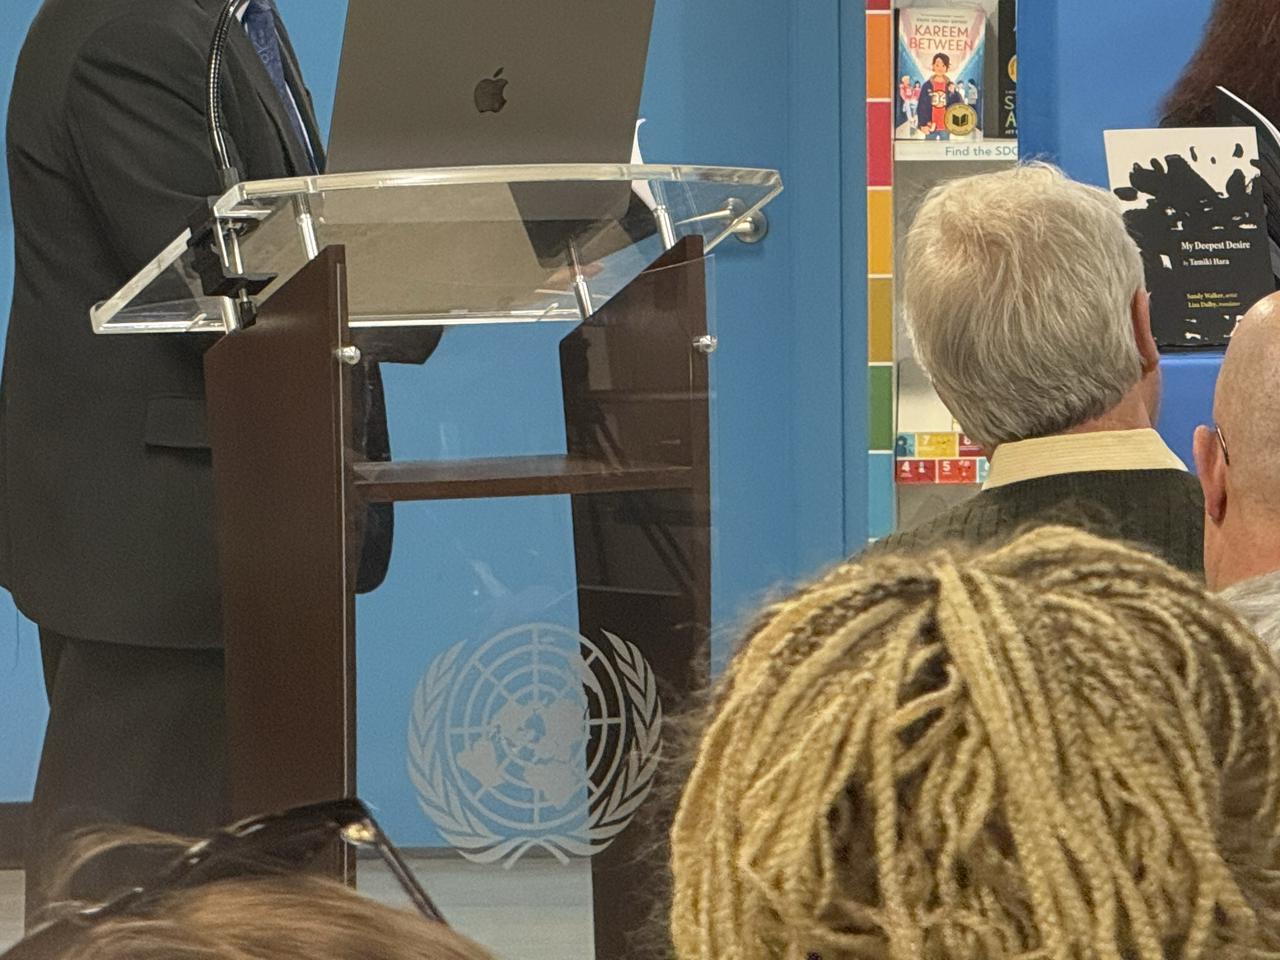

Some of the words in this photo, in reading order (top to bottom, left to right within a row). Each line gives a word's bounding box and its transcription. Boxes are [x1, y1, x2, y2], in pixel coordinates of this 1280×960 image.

[914, 24, 969, 38] KAREEM
[909, 37, 973, 51] BETWEEN
[945, 146, 969, 156] Find
[973, 146, 991, 156] the
[1181, 241, 1193, 252] My
[1194, 241, 1225, 252] Deepest
[1226, 240, 1251, 250] Desire
[1189, 258, 1213, 266] Tamiki
[922, 435, 930, 445] 7
[901, 461, 910, 472] 4
[942, 461, 951, 472] 5
